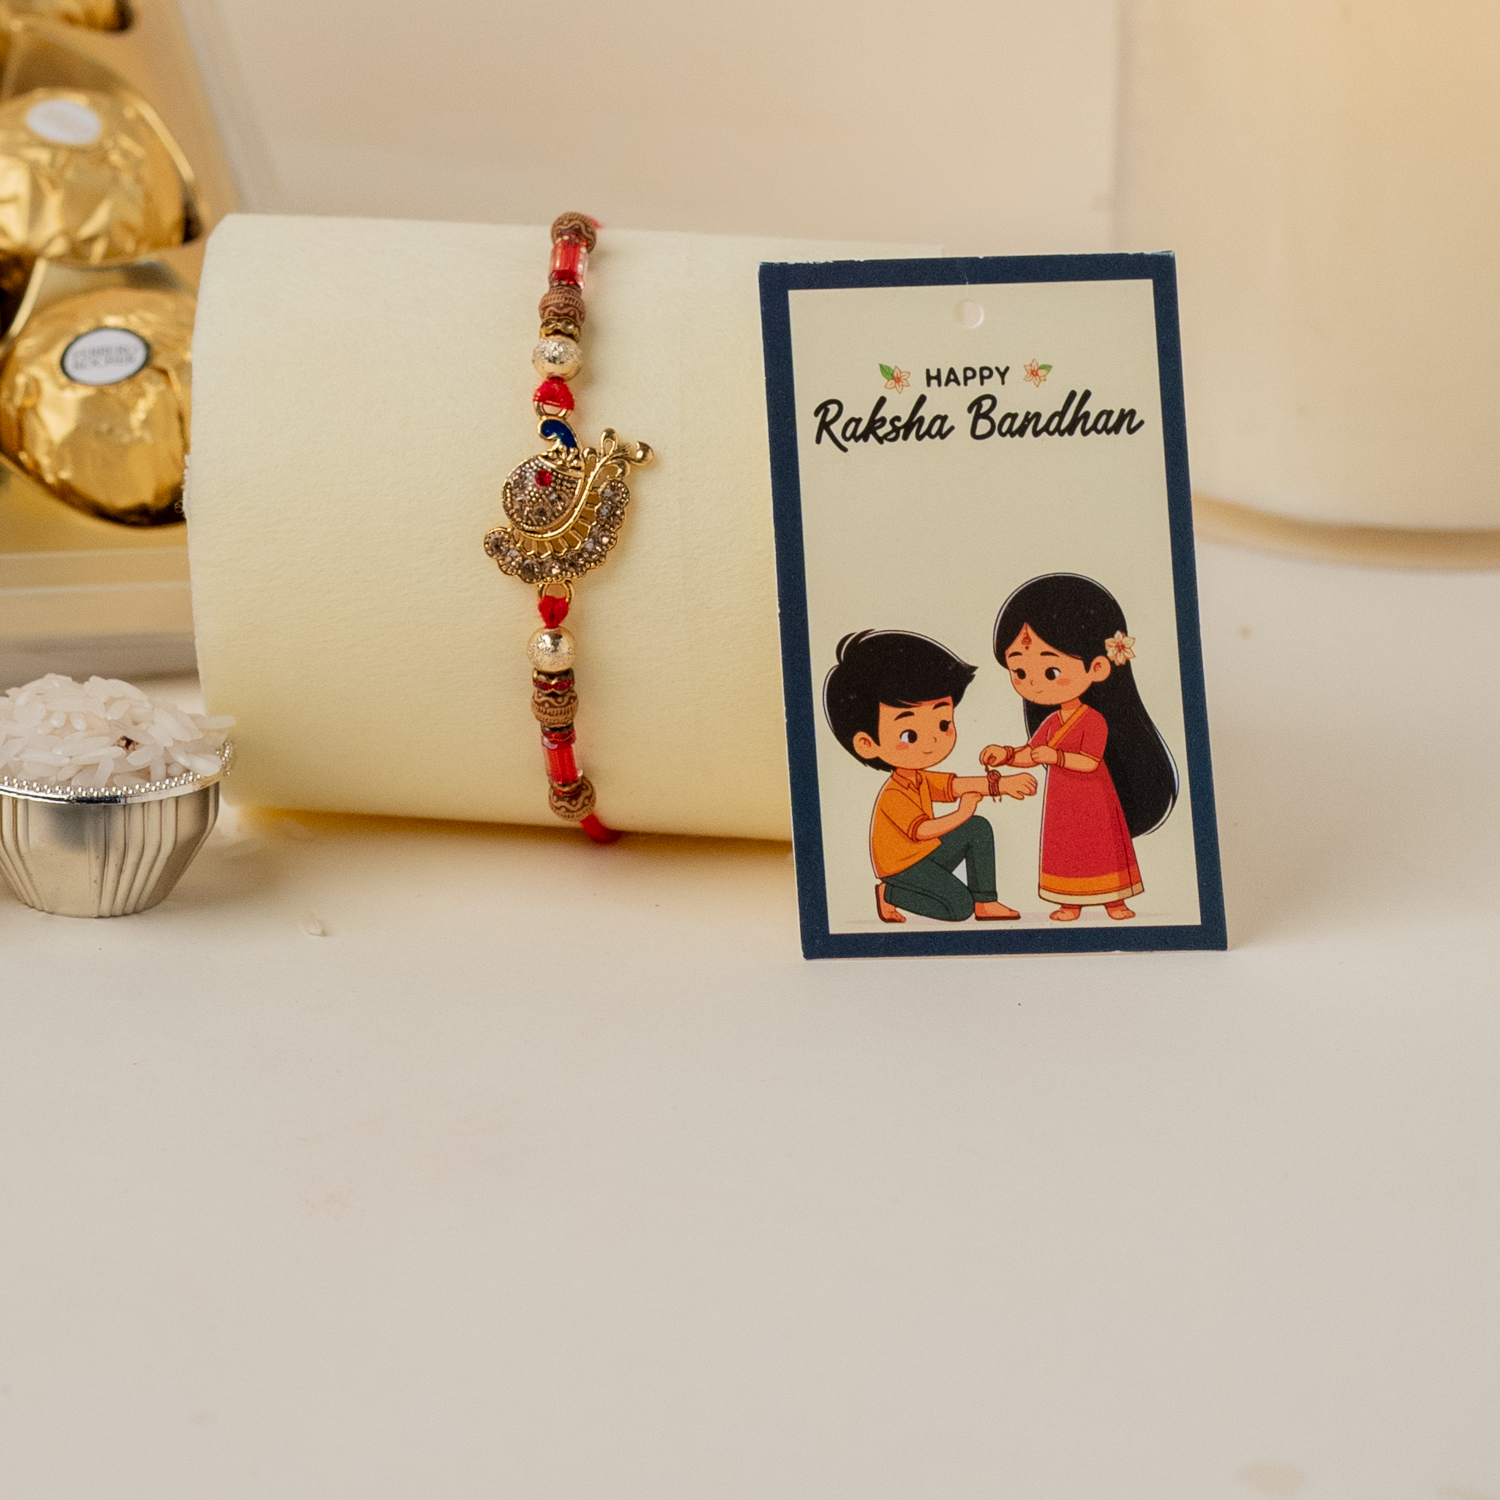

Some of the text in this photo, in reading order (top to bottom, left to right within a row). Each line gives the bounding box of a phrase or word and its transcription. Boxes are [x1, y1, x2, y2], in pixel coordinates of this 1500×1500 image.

[925, 365, 1010, 388] HAPPY
[813, 389, 1145, 453] Raksha Bandhan
